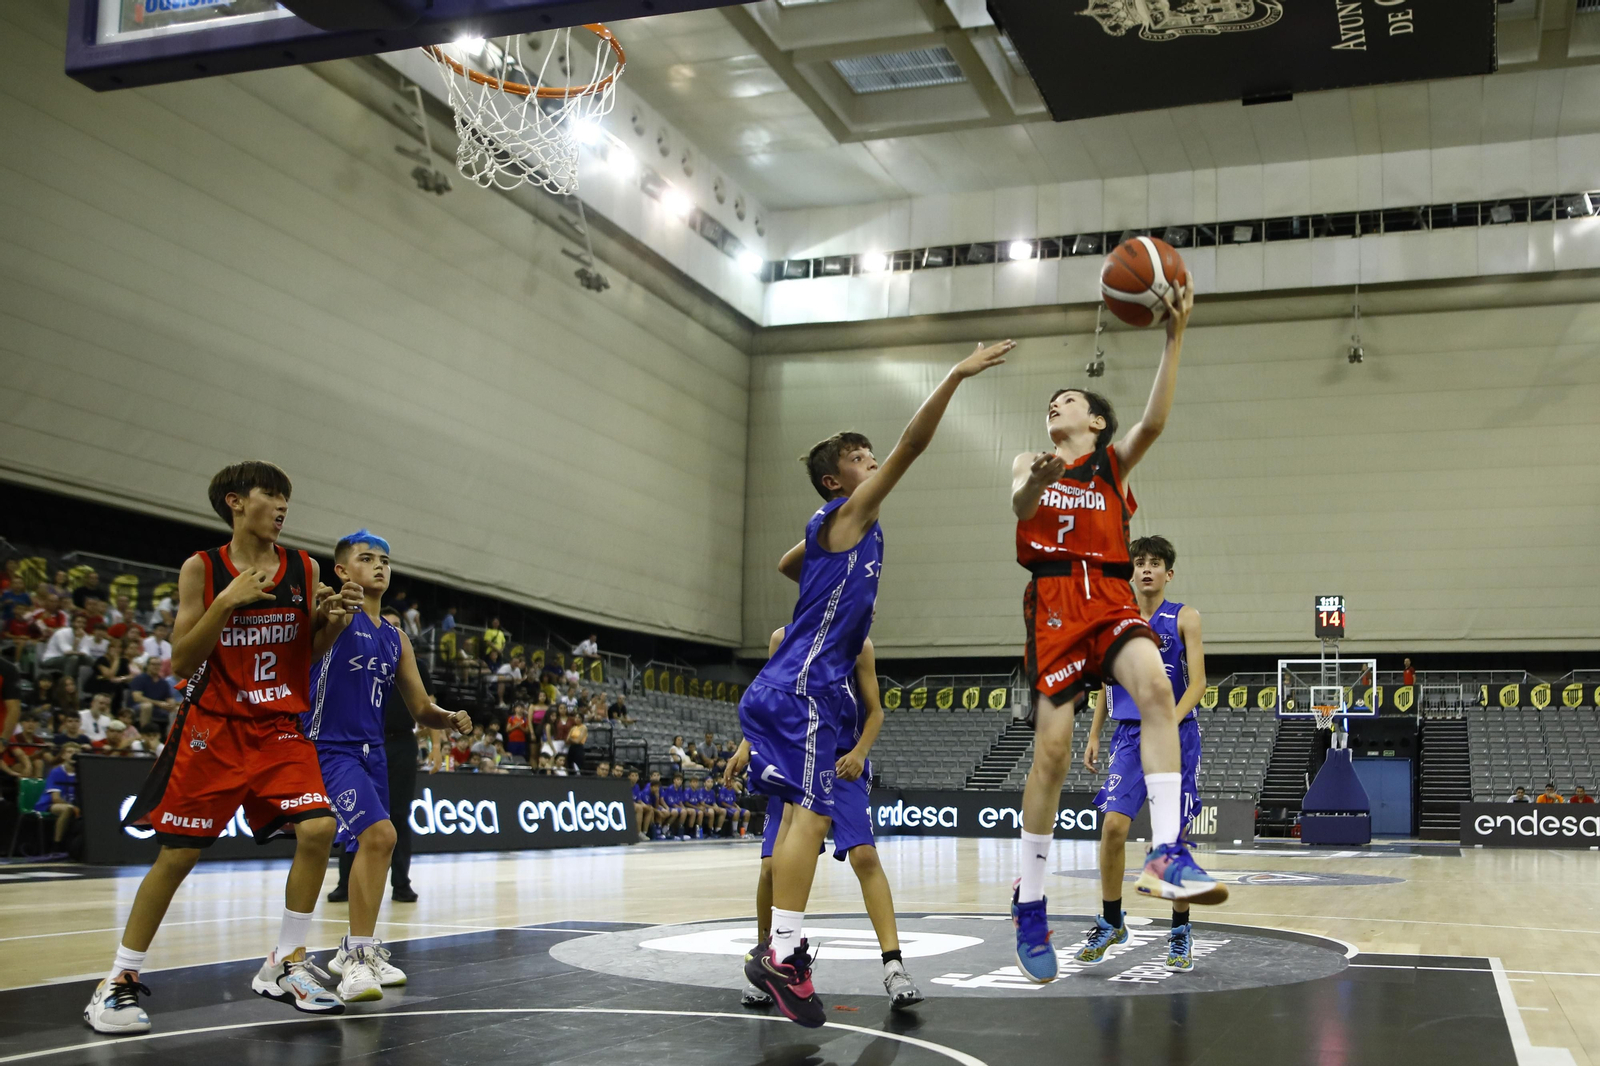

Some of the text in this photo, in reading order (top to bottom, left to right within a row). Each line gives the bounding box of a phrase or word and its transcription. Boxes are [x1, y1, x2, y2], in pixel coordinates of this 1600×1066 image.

[1331, 0, 1367, 51] AYUN
[1388, 9, 1414, 36] DE
[1039, 489, 1106, 511] RANADA
[1048, 482, 1086, 496] NDACION
[1057, 514, 1075, 544] 7
[233, 613, 296, 625] FUNDACION CB
[1319, 611, 1341, 627] 14
[254, 651, 277, 682] 12
[236, 683, 292, 704] PULEVA
[1397, 691, 1410, 707] 100
[280, 792, 323, 811] asisa
[408, 787, 628, 835] desa endesa
[161, 811, 213, 830] PULEVA
[877, 799, 958, 828] endesa
[978, 806, 1098, 831] ensa
[1474, 809, 1600, 837] endesa
